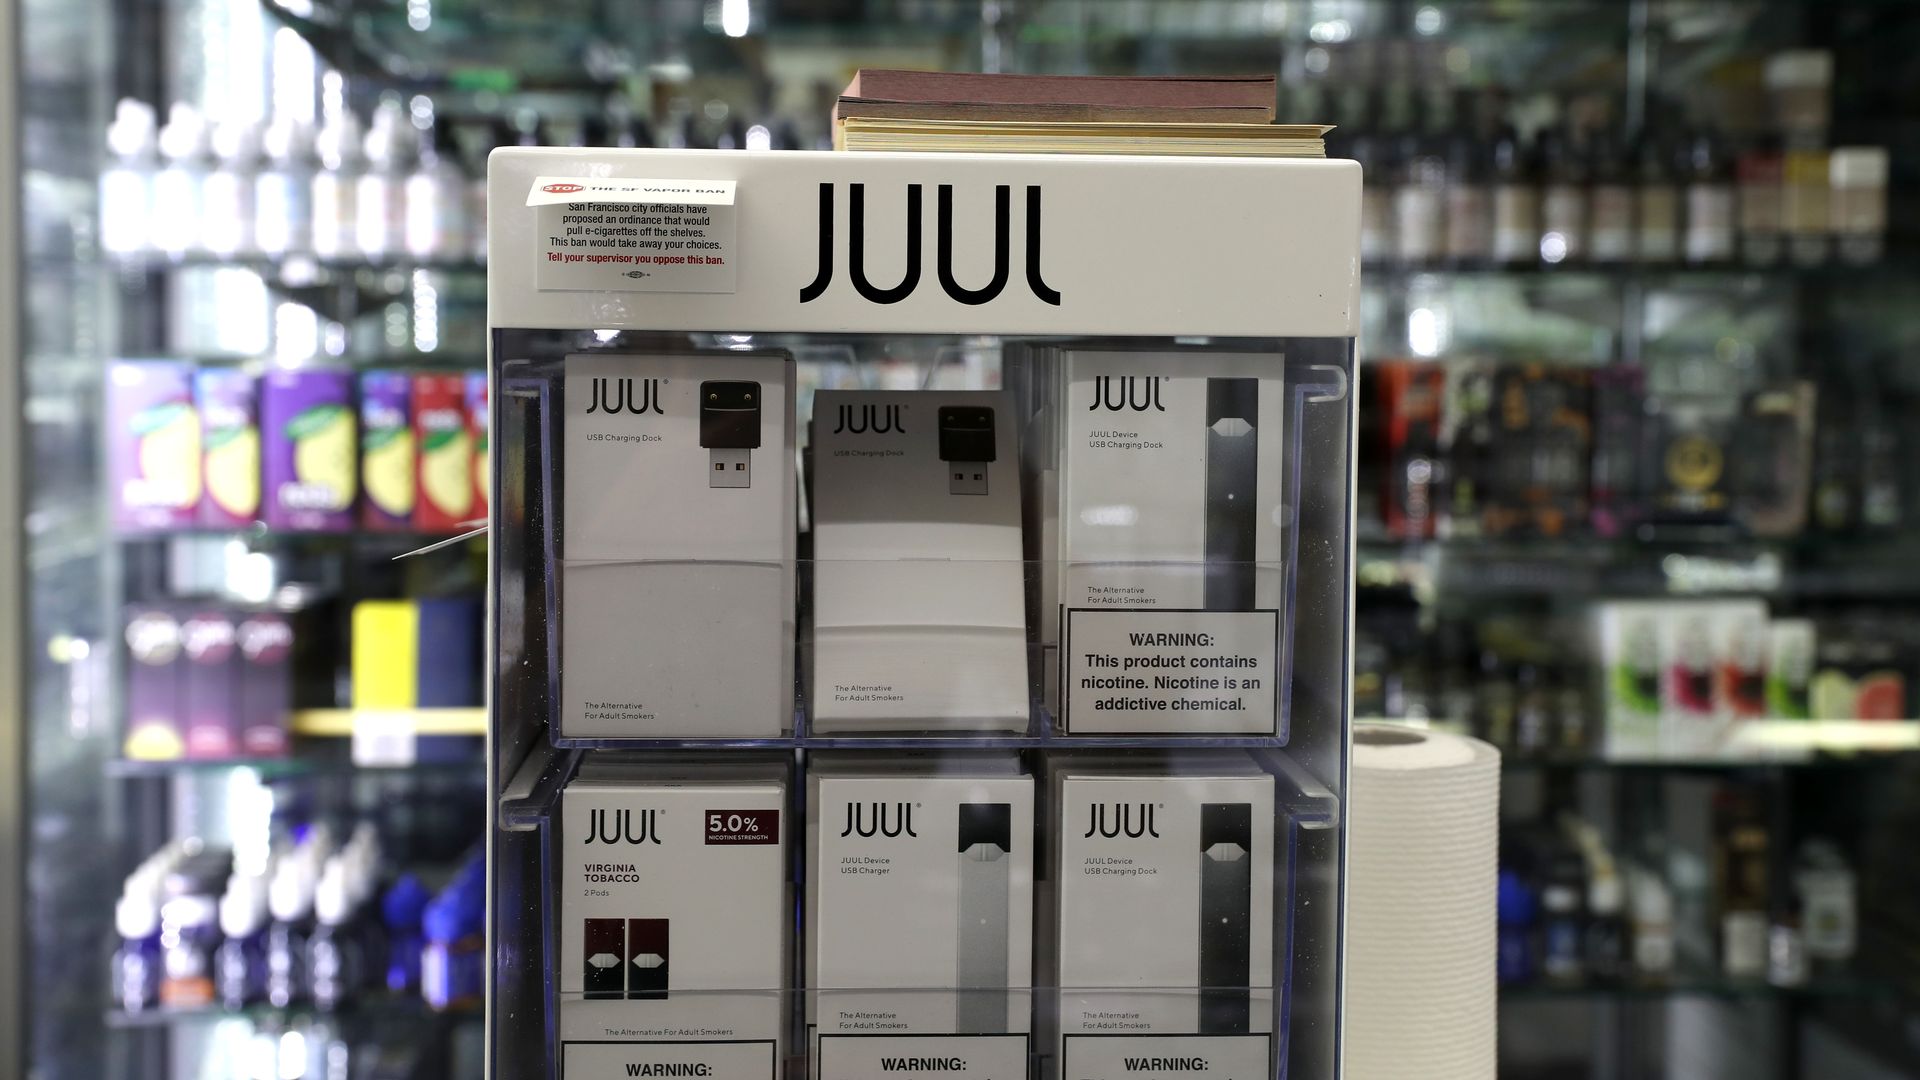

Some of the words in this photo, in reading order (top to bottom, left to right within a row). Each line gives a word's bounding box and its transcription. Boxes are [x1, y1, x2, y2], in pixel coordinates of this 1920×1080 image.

[568, 202, 585, 212] San
[588, 202, 630, 212] Francisco
[632, 204, 648, 214] city
[650, 204, 684, 214] officials
[686, 204, 708, 214] have
[562, 214, 604, 224] proposed
[618, 215, 662, 224] ordinance
[664, 216, 682, 225] that
[684, 216, 710, 226] would
[566, 226, 582, 237] pull
[585, 226, 637, 237] e-cigarettes
[640, 227, 652, 236] off
[654, 227, 668, 236] the
[670, 228, 705, 238] shelves.
[550, 237, 568, 247] This
[571, 237, 587, 247] ban
[590, 238, 615, 248] would
[618, 238, 637, 248] take
[640, 240, 662, 250] away
[665, 241, 684, 250] your
[686, 239, 722, 249] choices.
[800, 183, 1060, 306] JUUL
[547, 252, 562, 262] Tell
[564, 254, 584, 264] your
[587, 253, 633, 264] supervisor
[635, 255, 651, 264] you
[653, 256, 685, 265] oppose
[687, 254, 704, 264] this
[706, 255, 725, 265] ban.
[606, 434, 640, 442] Charging
[1107, 441, 1141, 450] Charging
[1130, 633, 1214, 646] WARNING:
[1085, 654, 1118, 667] This
[1124, 655, 1185, 670] product
[1190, 655, 1257, 668] contains
[1081, 676, 1148, 689] nicotine.
[1154, 676, 1219, 689] Nicotine
[1224, 676, 1237, 689] is
[1242, 679, 1260, 689] an
[1095, 698, 1166, 710] addictive
[1171, 698, 1246, 711] chemical.
[709, 815, 758, 832] 5.0%
[626, 1064, 712, 1076] WARNING:
[882, 1058, 966, 1071] WARNING:
[1125, 1058, 1209, 1071] WARNING:
